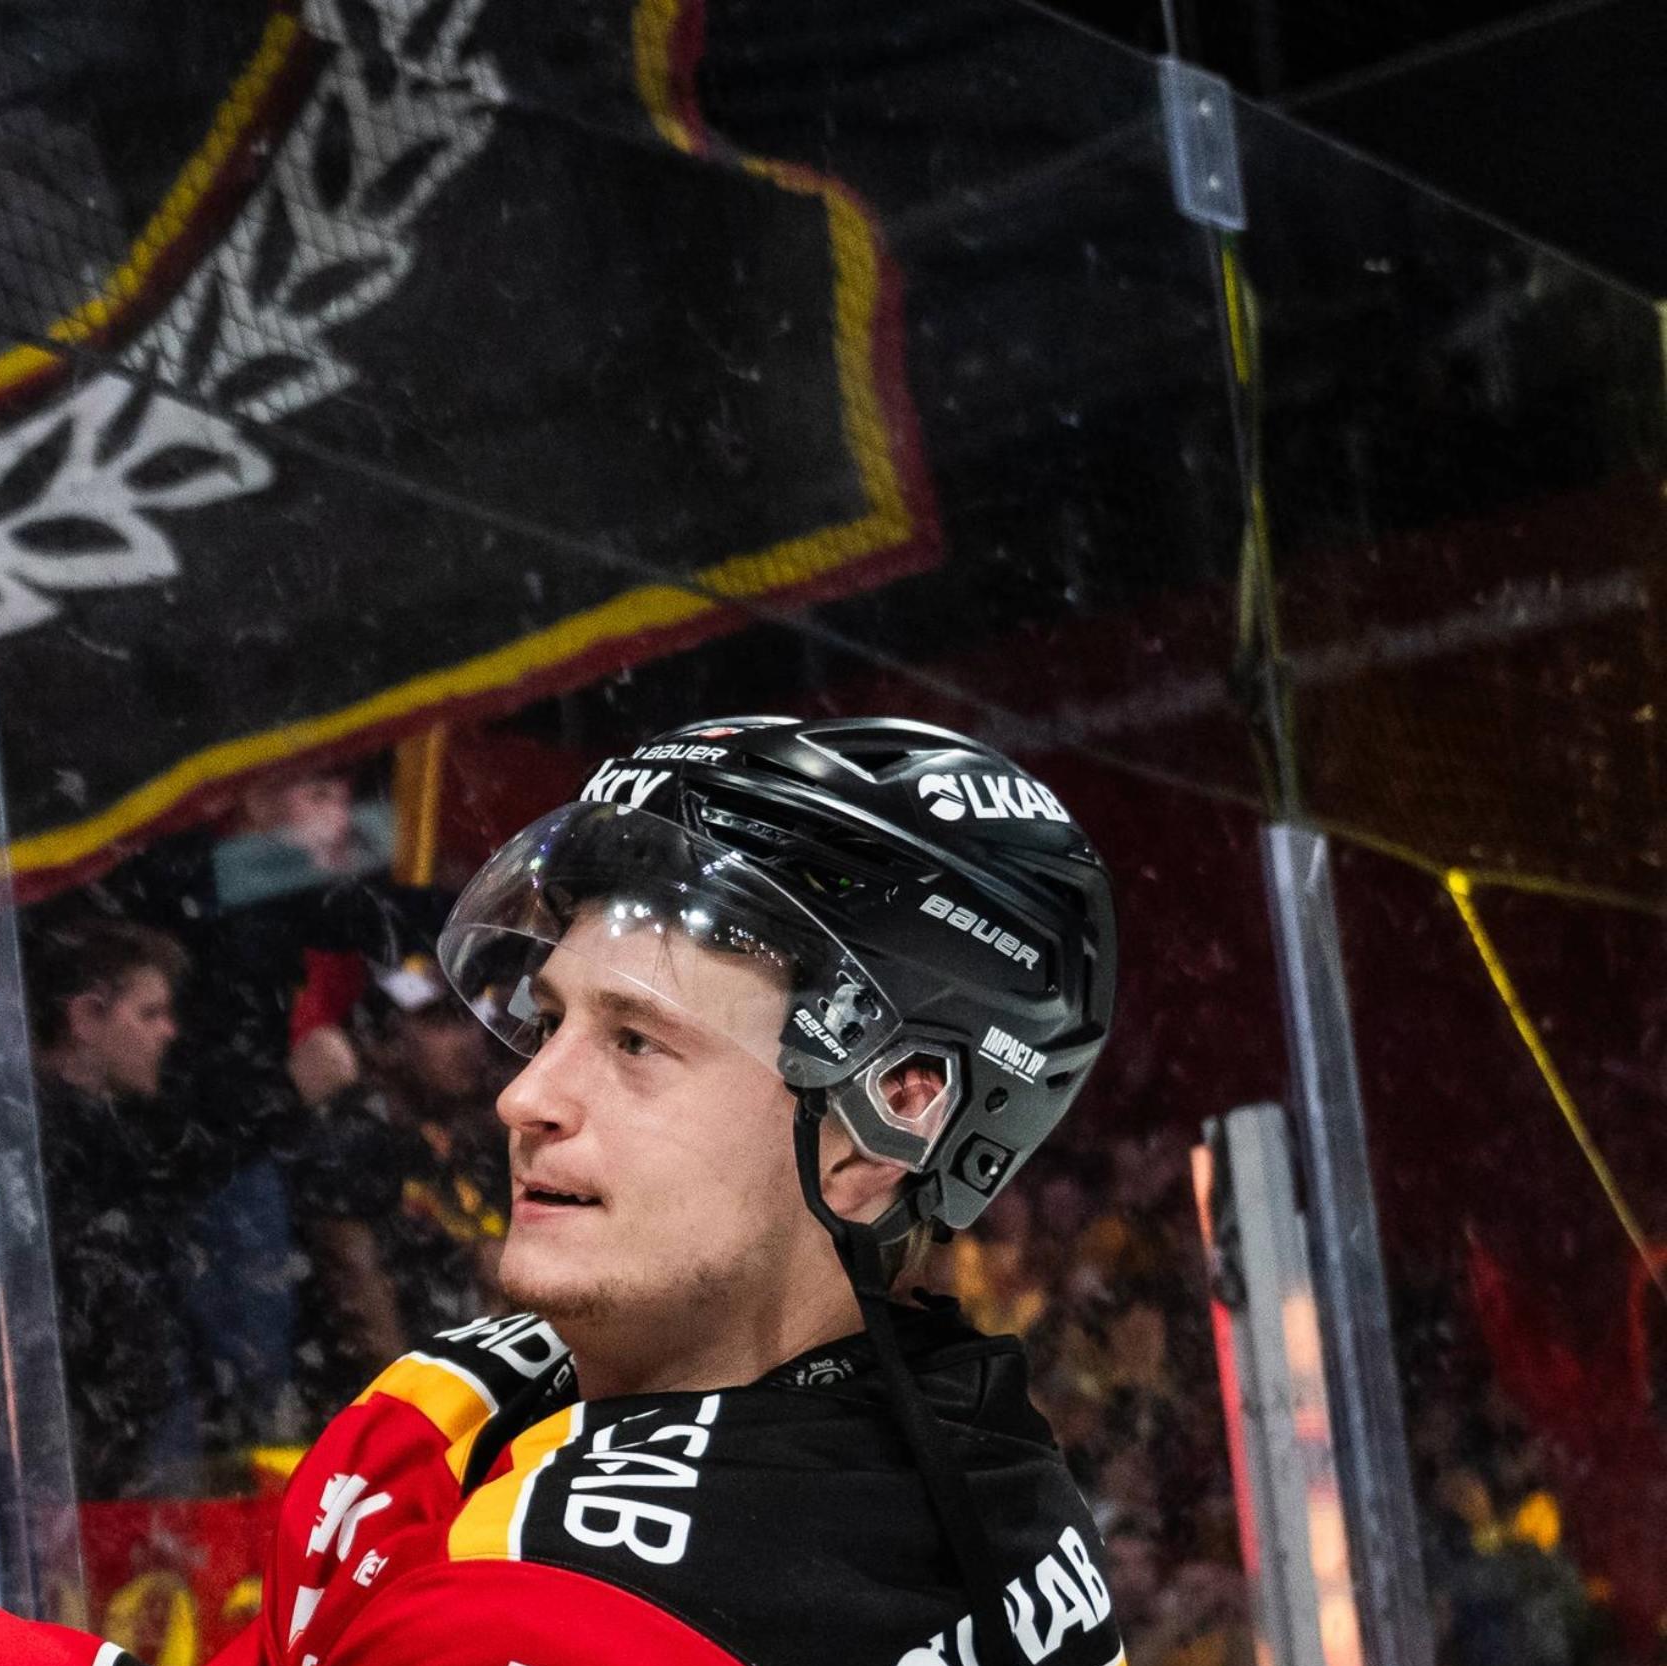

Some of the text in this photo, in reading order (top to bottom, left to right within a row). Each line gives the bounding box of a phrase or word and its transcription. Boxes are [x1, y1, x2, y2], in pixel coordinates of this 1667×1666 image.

[579, 758, 673, 816] kry
[959, 773, 1071, 824] LKAB
[981, 1025, 1047, 1077] IMPACT BY
